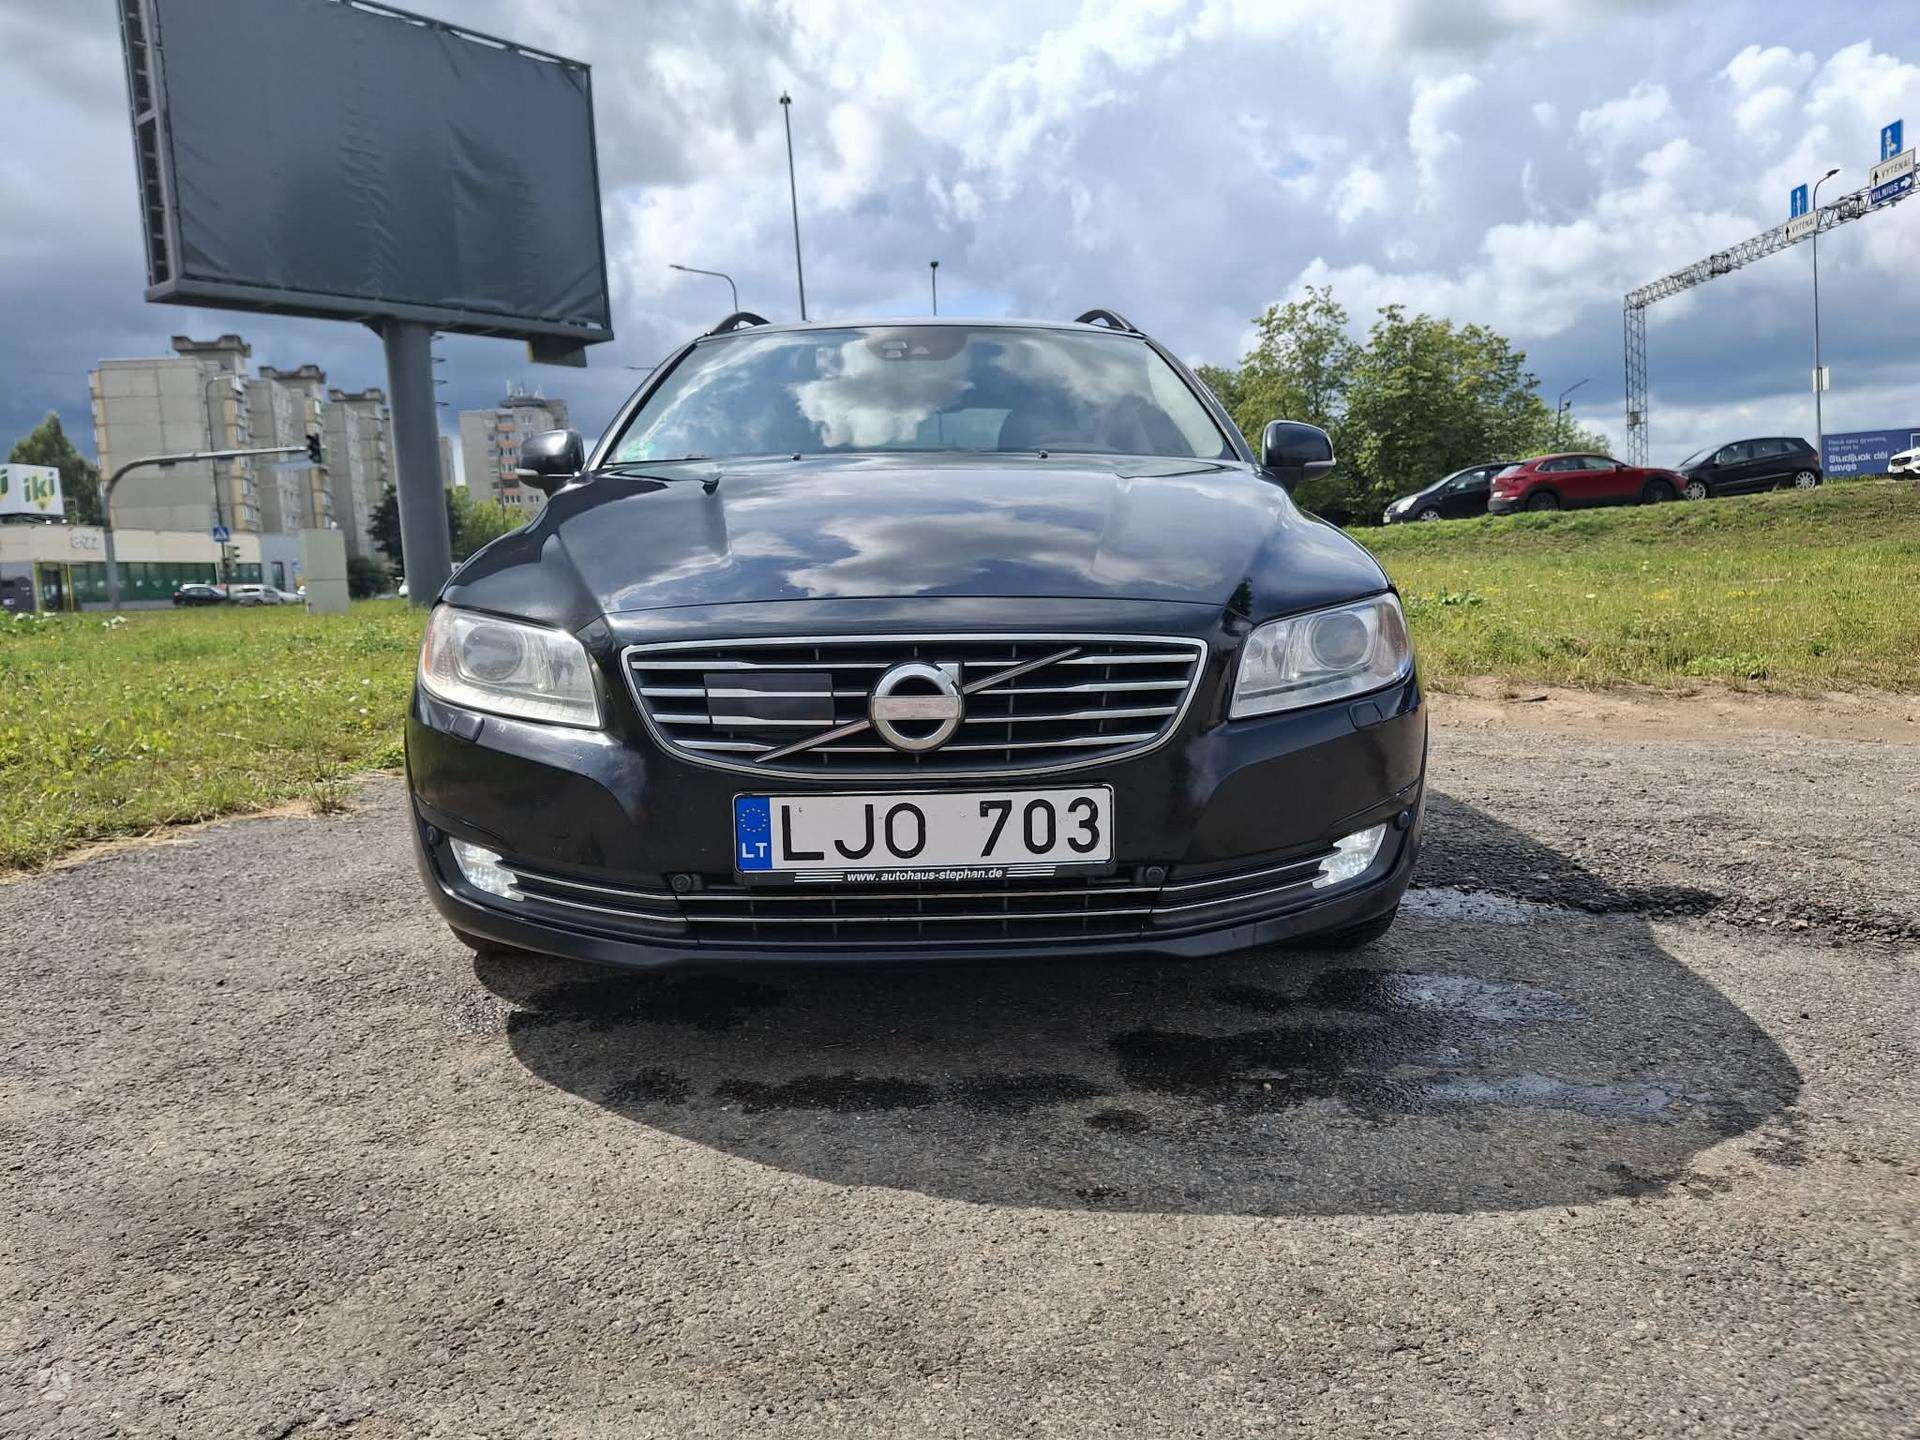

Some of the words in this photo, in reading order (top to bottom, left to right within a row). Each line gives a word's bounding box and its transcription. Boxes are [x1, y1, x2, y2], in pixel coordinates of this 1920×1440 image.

[1871, 182, 1899, 202] VILNIUS
[23, 471, 55, 502] iki
[781, 802, 927, 862] LJO
[979, 796, 1102, 858] 703
[741, 842, 768, 858] LT
